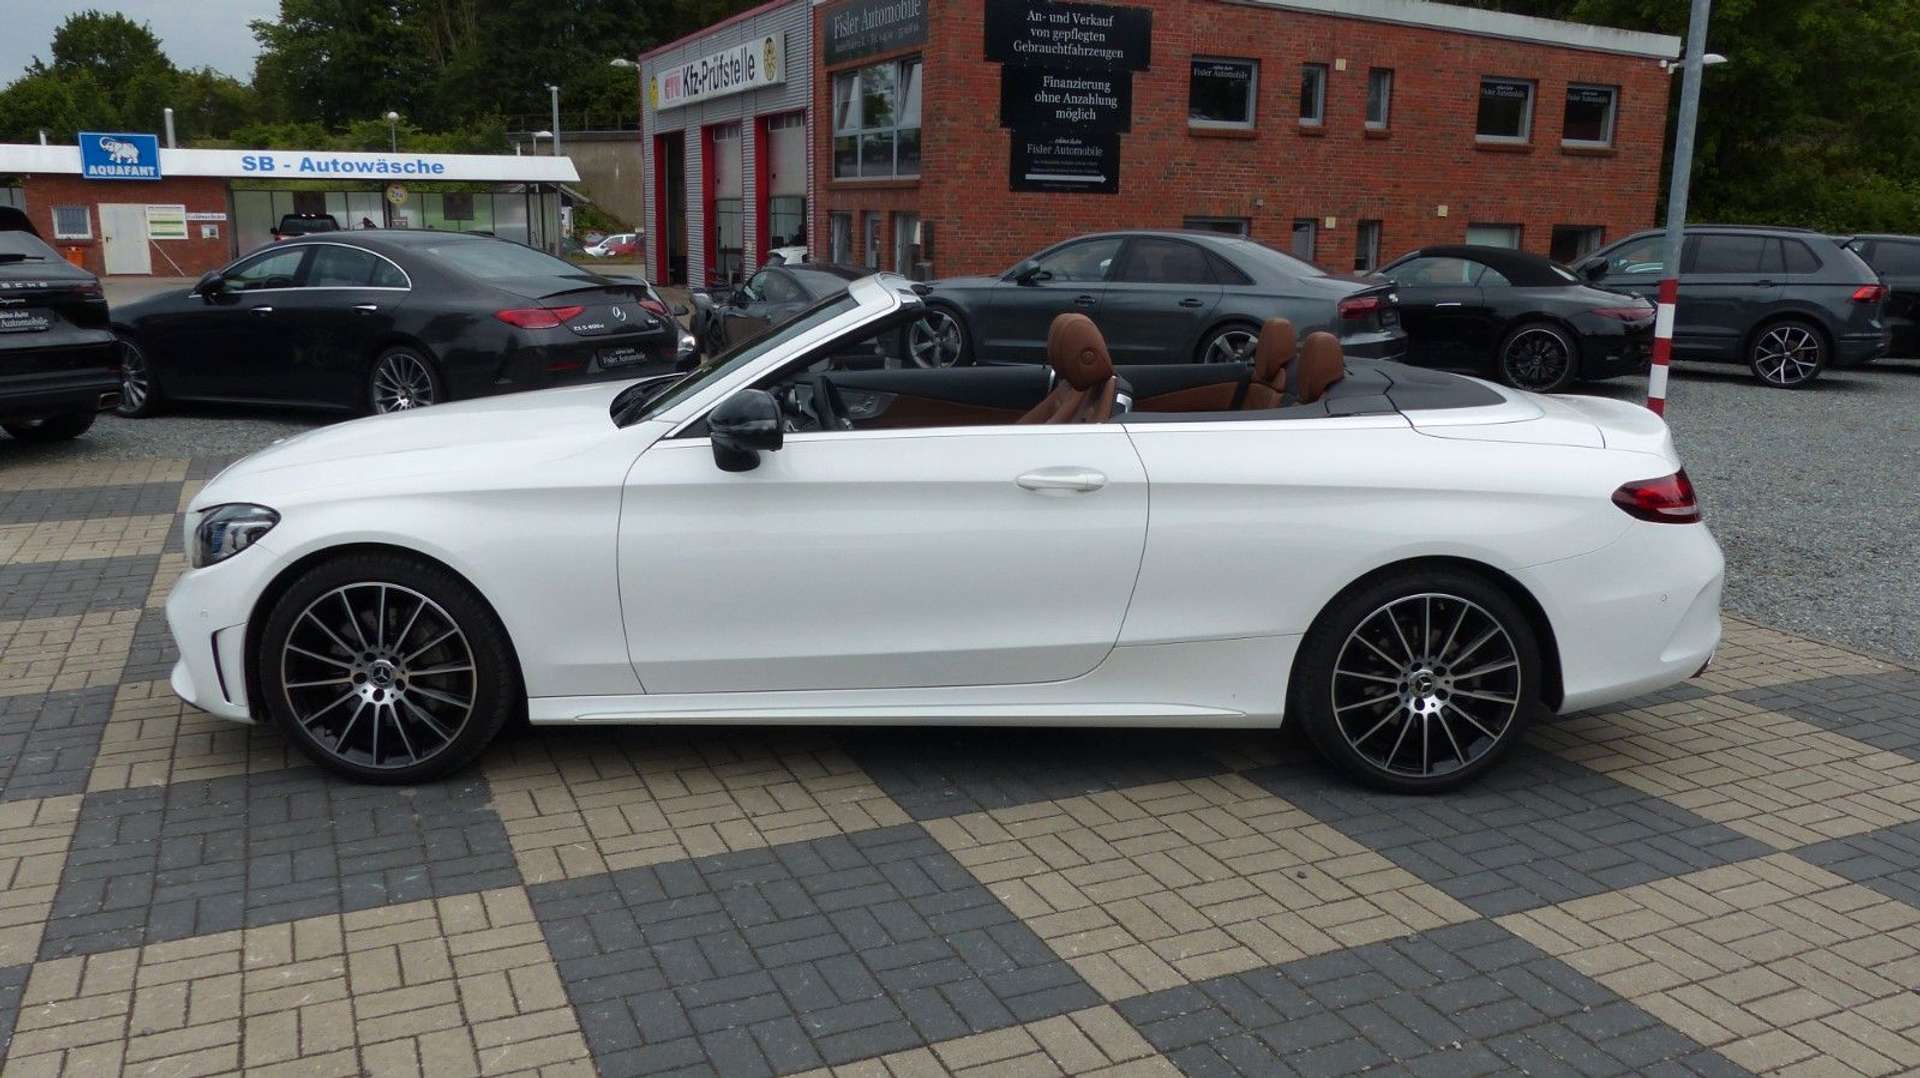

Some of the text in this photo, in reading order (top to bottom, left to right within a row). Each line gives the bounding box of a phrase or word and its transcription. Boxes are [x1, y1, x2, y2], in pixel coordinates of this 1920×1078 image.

[833, 12, 860, 39] Fisler
[861, 0, 921, 32] Automobile
[1026, 10, 1114, 27] An- und Verkauf
[1030, 28, 1106, 43] von gepflegten
[1013, 40, 1124, 60] Gebrauchtfahrzeugen
[682, 45, 755, 98] Kfz-Prüfstelle
[1043, 75, 1111, 93] Finanzierung
[1034, 90, 1118, 109] ohne Anzahlung
[1056, 107, 1096, 122] möglich
[1026, 143, 1103, 156] Fisler Automobile
[89, 165, 155, 176] AQUAFANT
[241, 155, 275, 171] SB
[300, 157, 445, 174] Autowäsche
